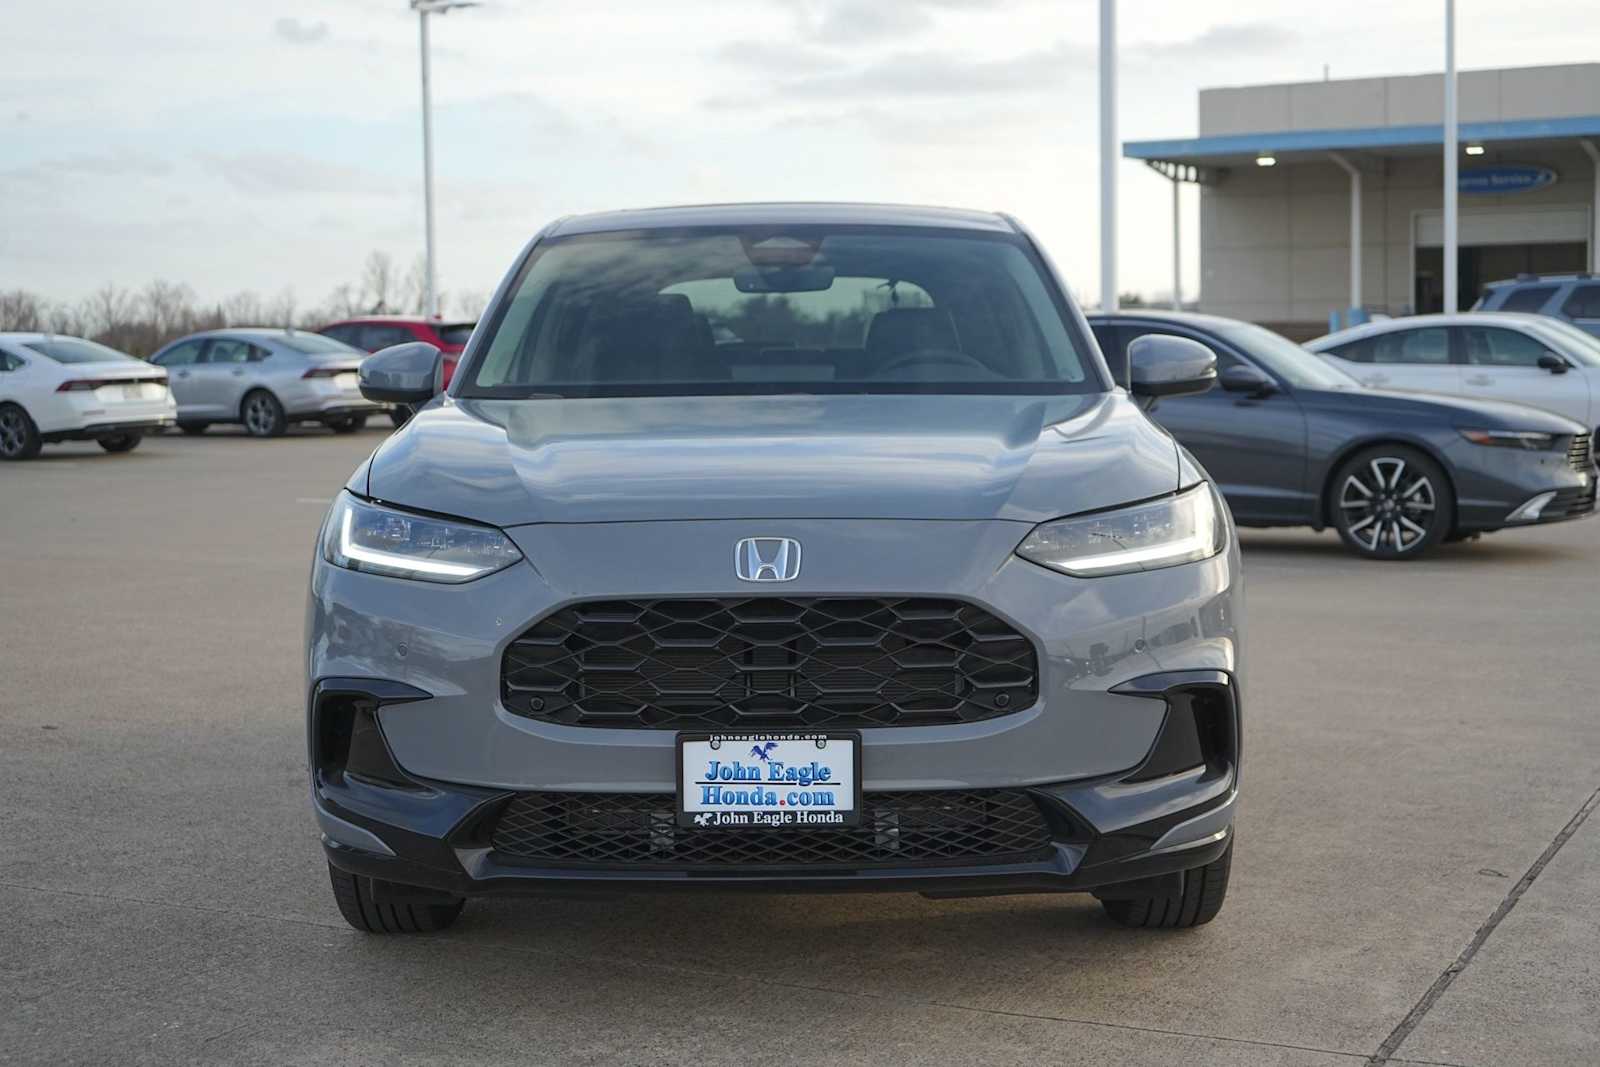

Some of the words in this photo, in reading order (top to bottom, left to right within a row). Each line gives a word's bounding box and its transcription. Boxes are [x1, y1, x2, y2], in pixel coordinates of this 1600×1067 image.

[705, 761, 761, 781] John
[768, 761, 831, 786] Eagle
[701, 786, 835, 806] Honda.com
[713, 812, 749, 825] John
[753, 812, 792, 826] Eagle
[797, 811, 844, 823] Honda
